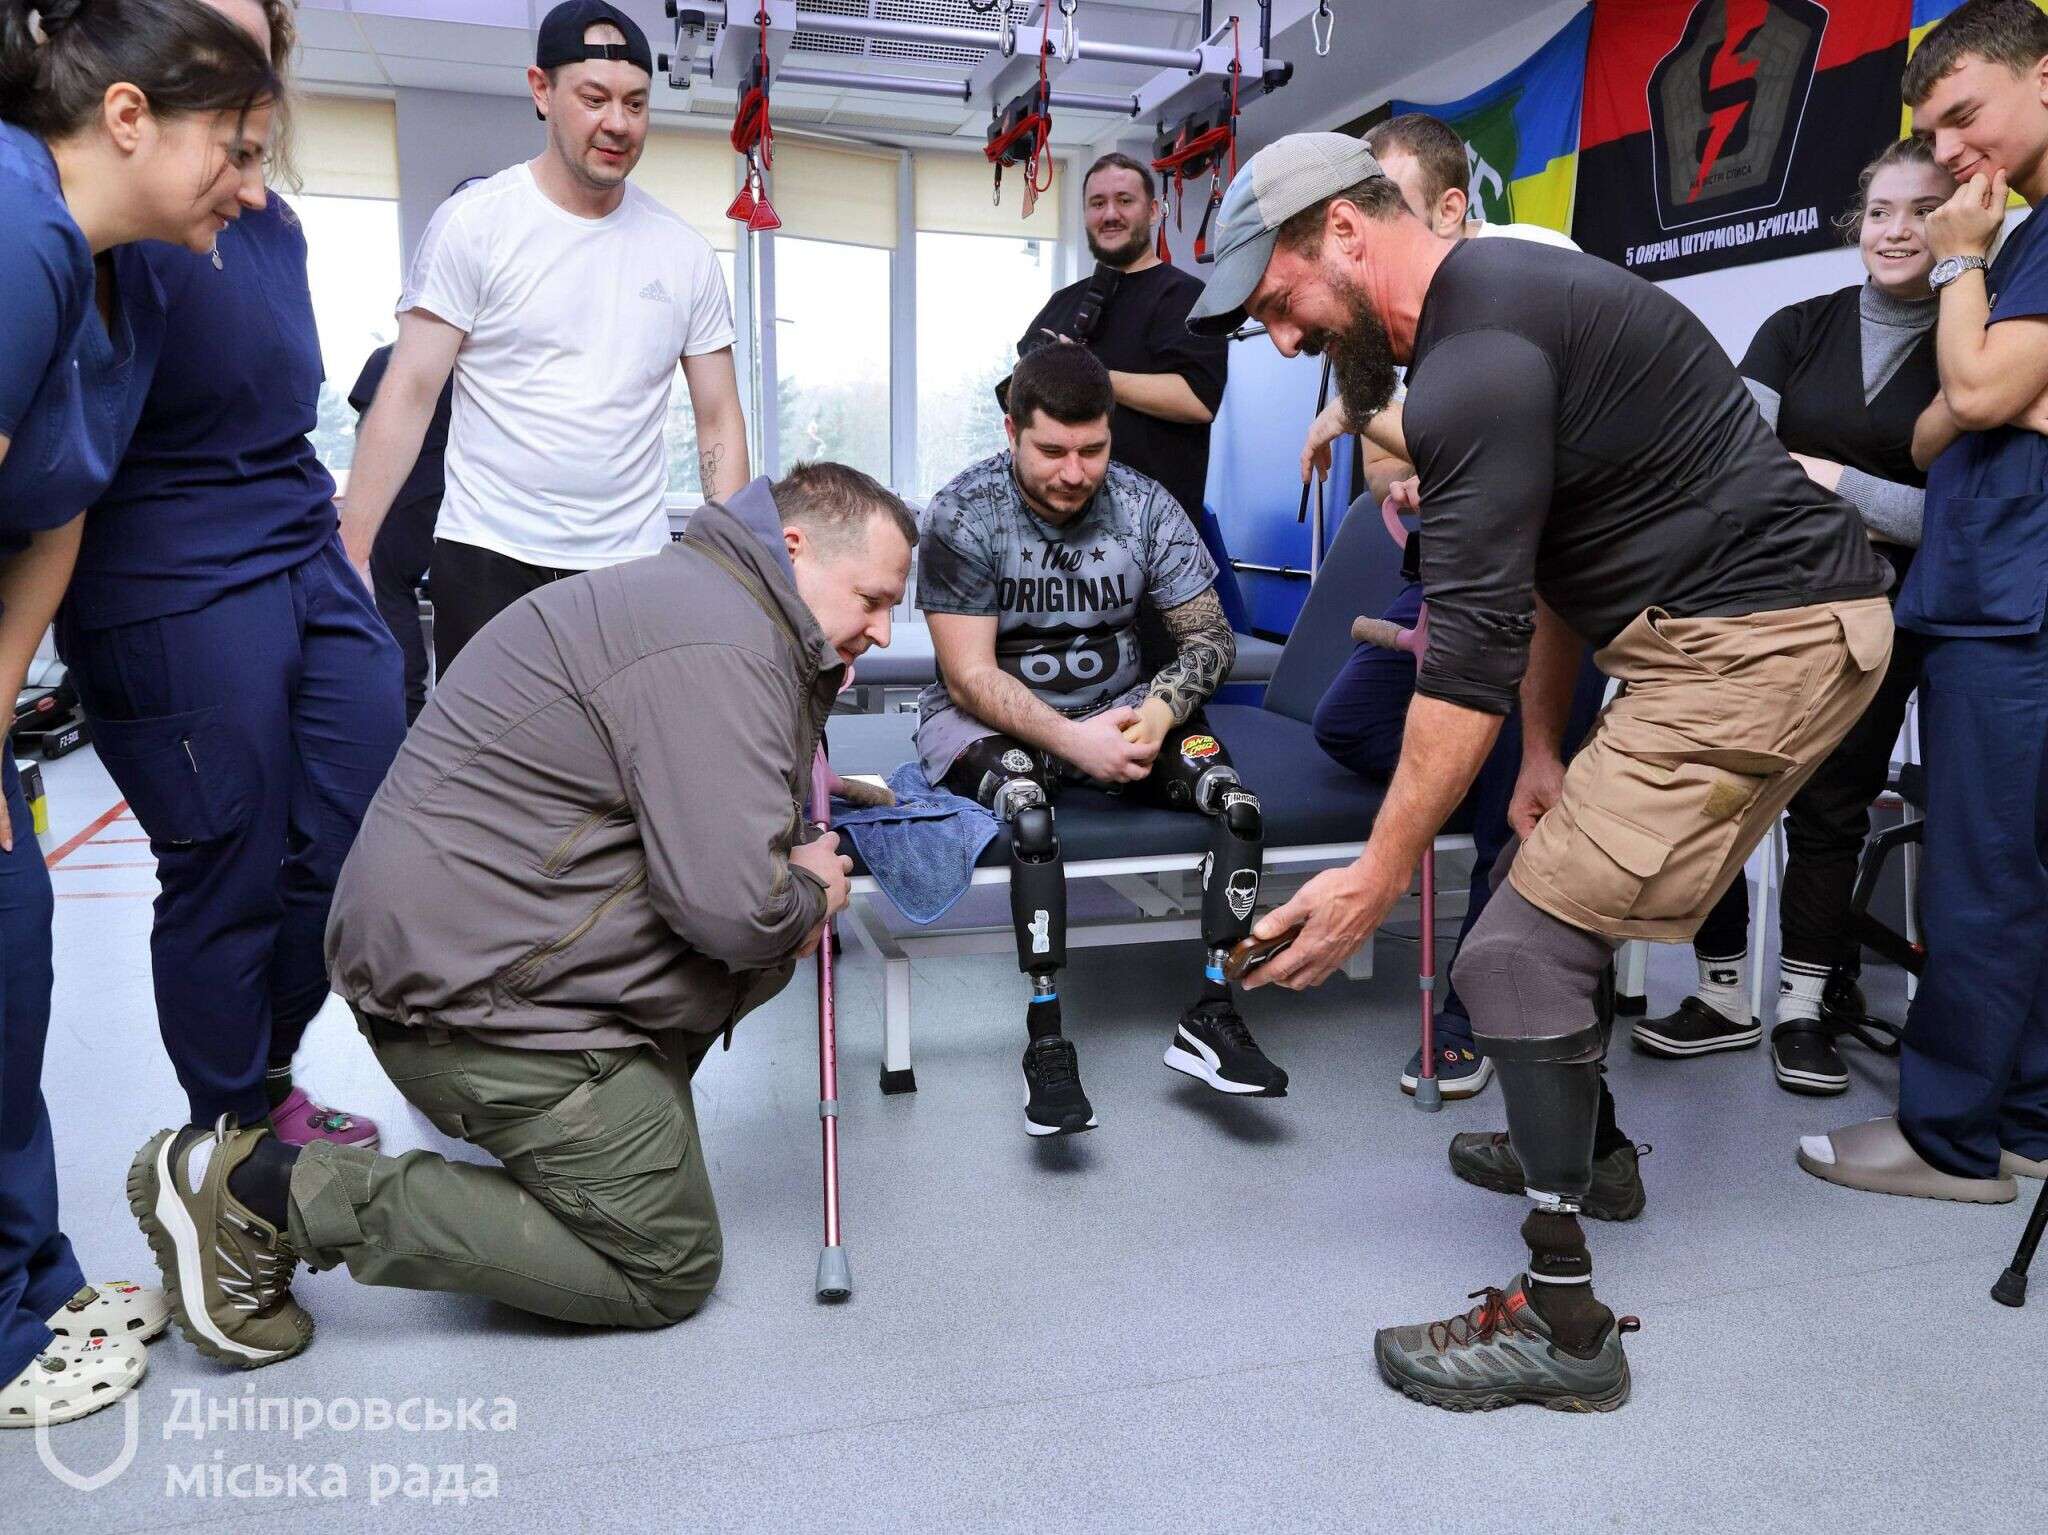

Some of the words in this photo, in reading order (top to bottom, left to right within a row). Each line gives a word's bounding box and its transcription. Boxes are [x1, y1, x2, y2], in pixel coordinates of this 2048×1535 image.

[1626, 247, 1635, 266] 5
[1636, 238, 1680, 264] ОКРЕМА
[1681, 221, 1754, 256] ШТУРМОВА
[1755, 207, 1819, 241] БРИГАДА
[1037, 538, 1084, 572] The
[1000, 574, 1133, 613] ORIGINAL
[1020, 634, 1103, 683] 66
